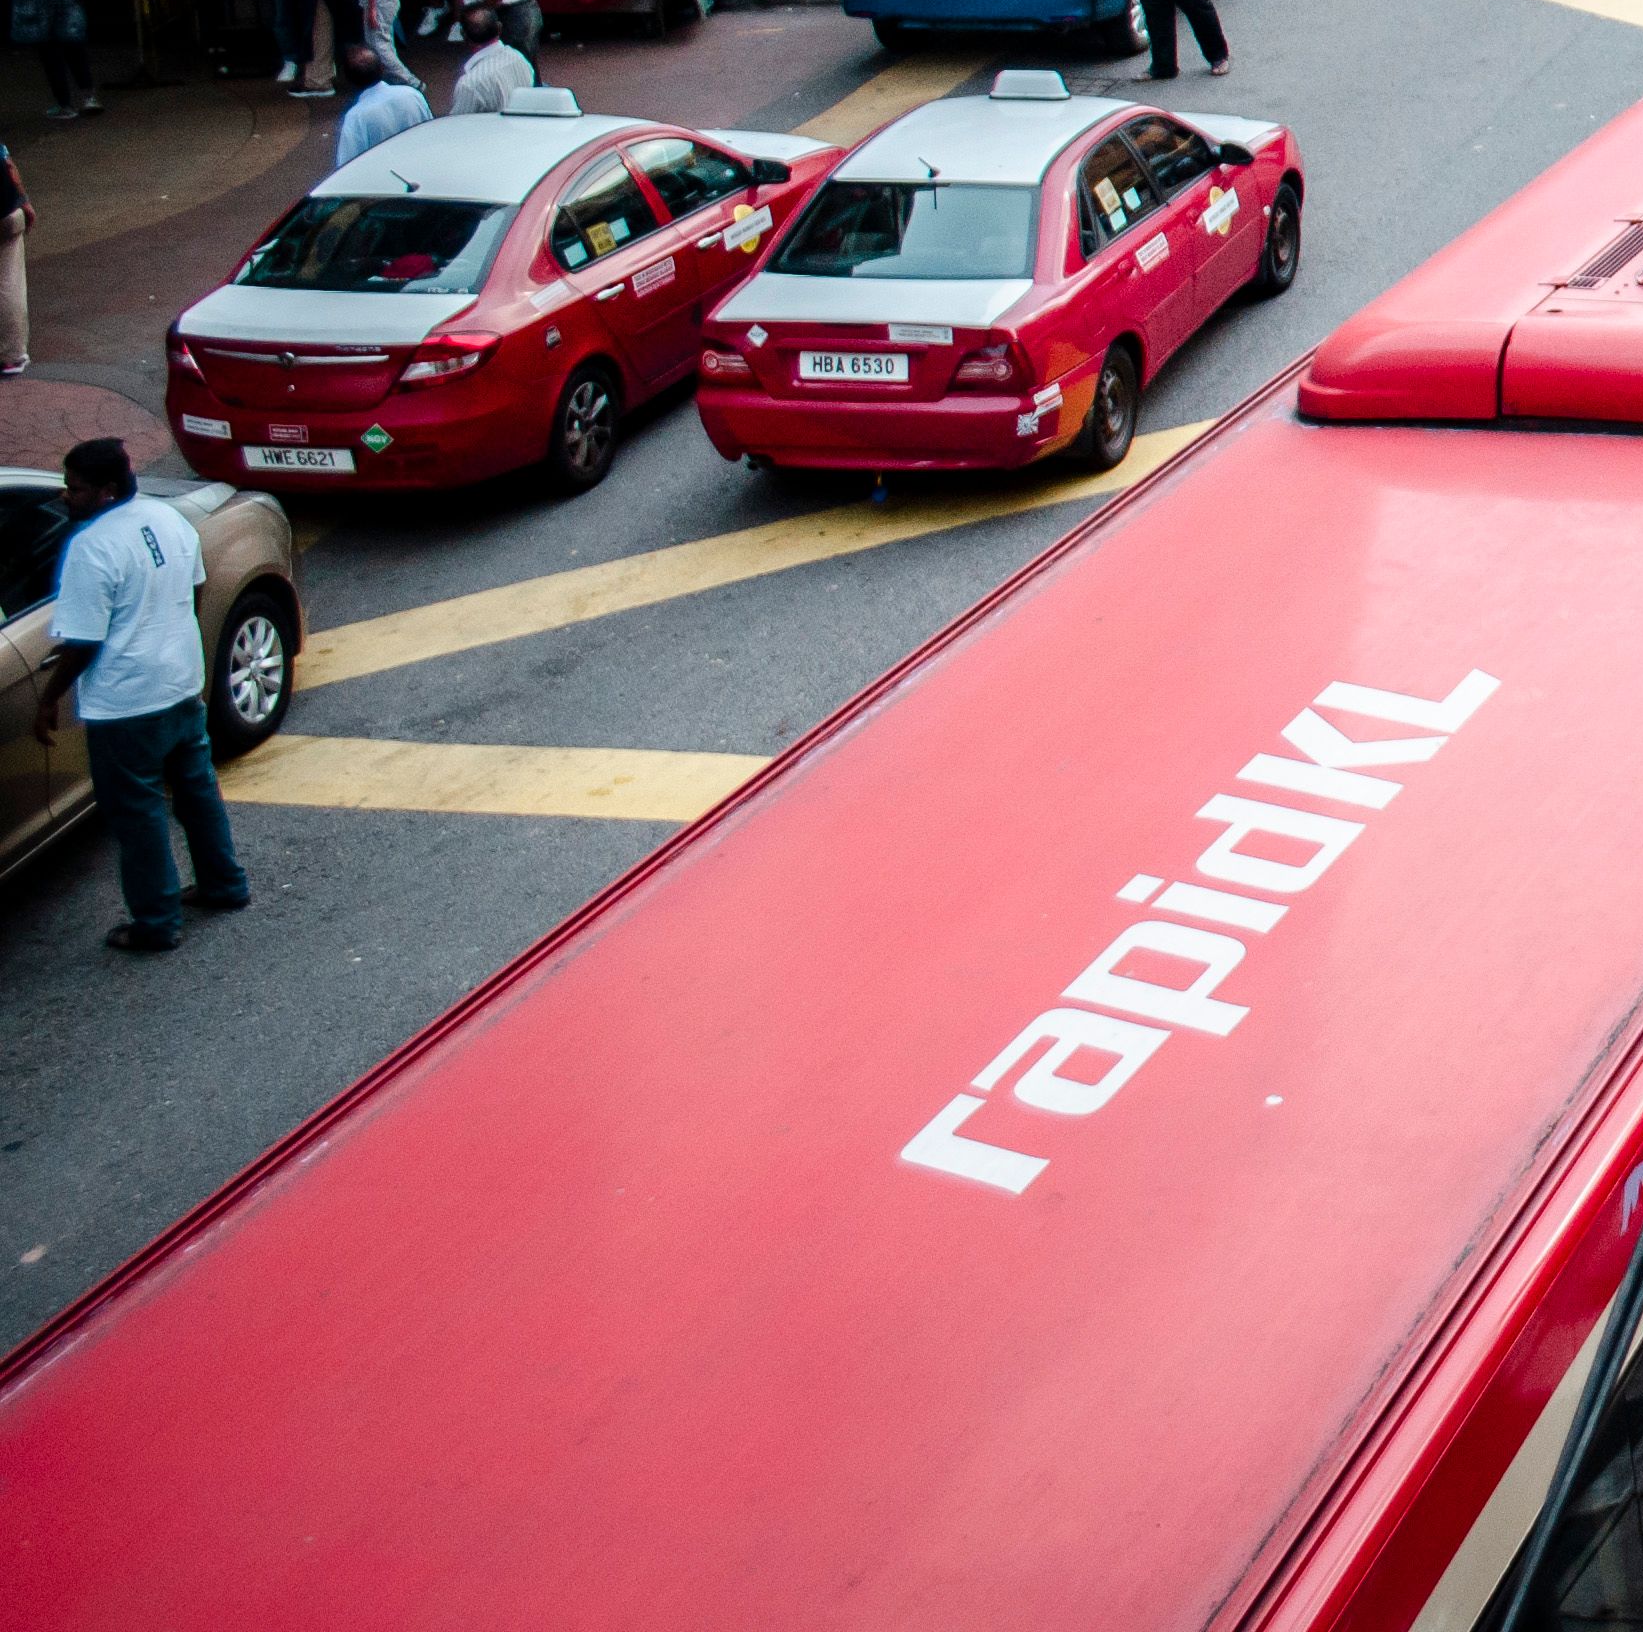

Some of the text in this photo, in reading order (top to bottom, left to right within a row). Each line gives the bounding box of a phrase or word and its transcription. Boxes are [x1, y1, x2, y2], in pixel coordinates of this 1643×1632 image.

[812, 355, 895, 375] HBA 6530
[261, 448, 337, 467] HWE 6621
[901, 668, 1502, 1195] rapidKL
